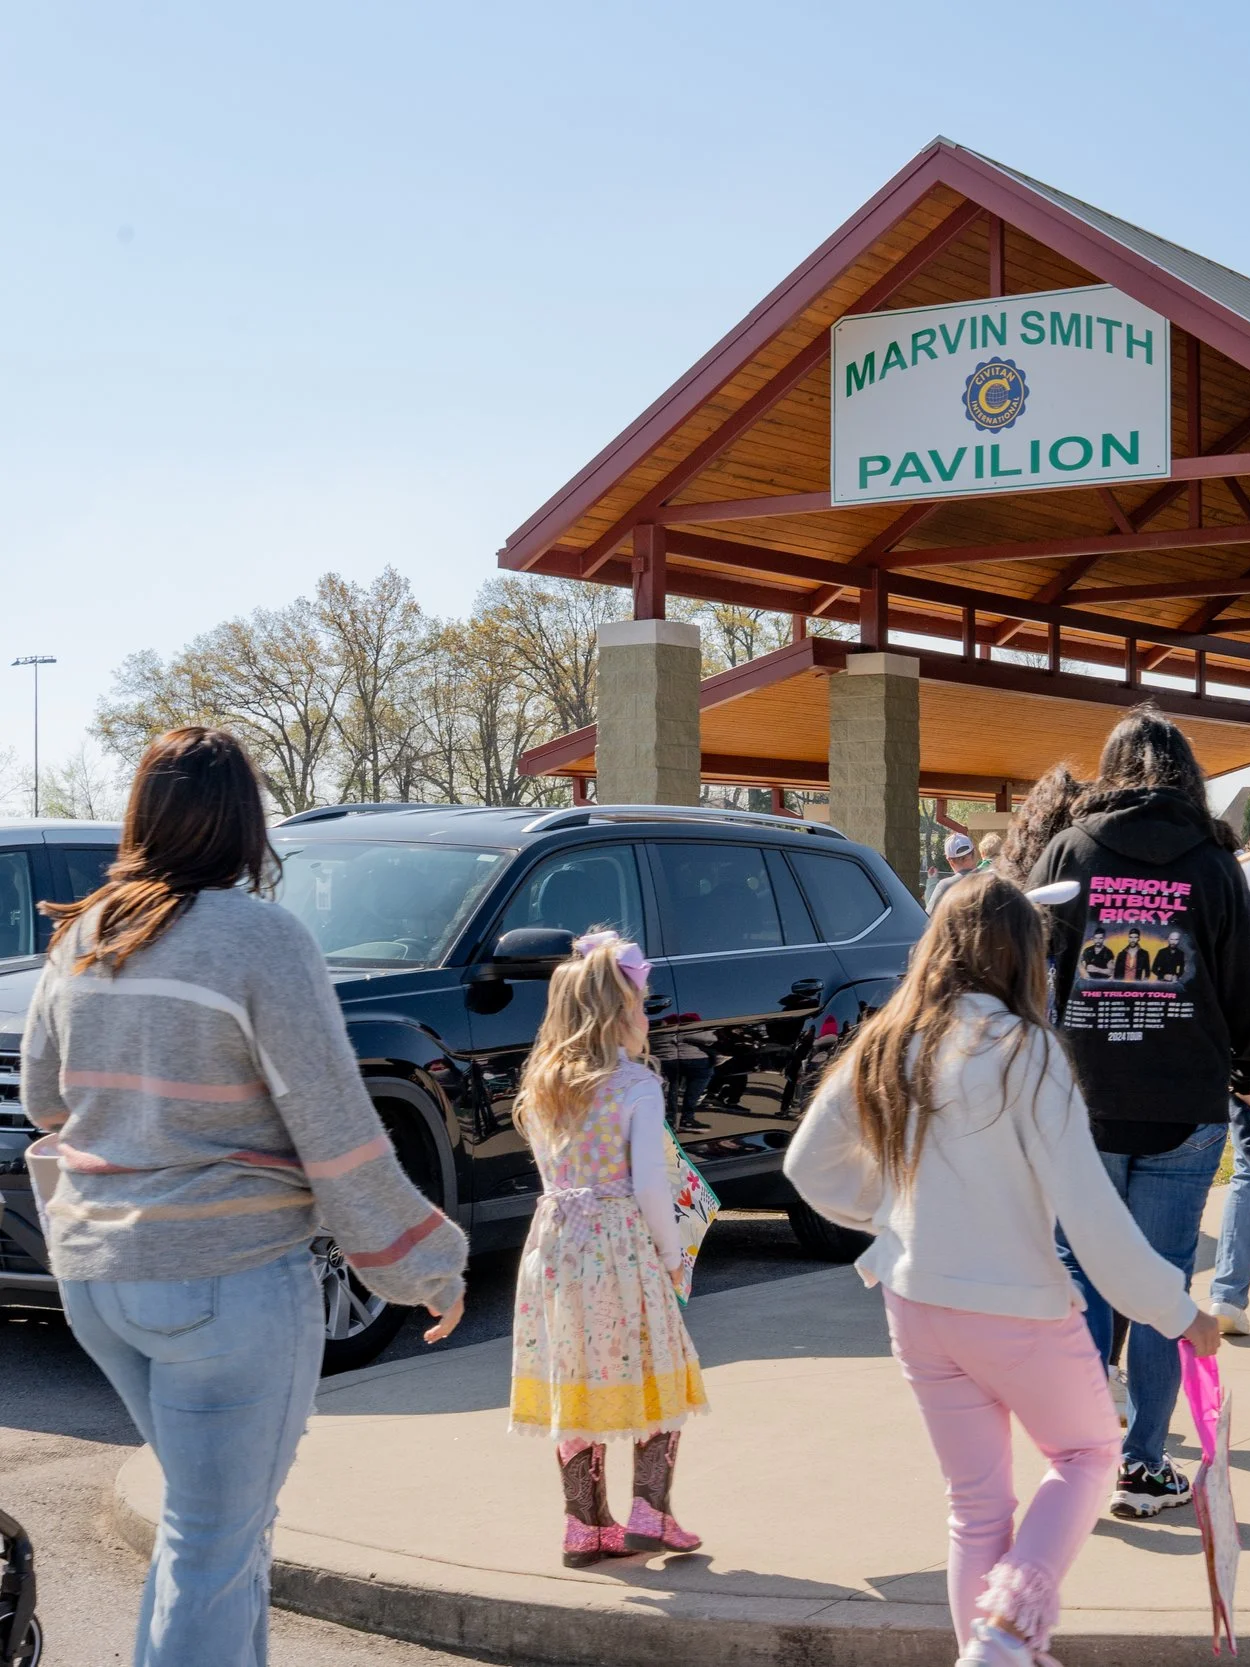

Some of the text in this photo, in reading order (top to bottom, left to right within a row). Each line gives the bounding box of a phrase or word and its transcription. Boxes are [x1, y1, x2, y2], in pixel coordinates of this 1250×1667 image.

[846, 310, 1153, 398] MARVIN SMITH
[975, 367, 1016, 385] CIVITAN
[978, 378, 1011, 414] C
[972, 396, 1020, 424] INTERNATIONAL
[858, 430, 1139, 490] PAVILION
[1090, 876, 1191, 895] ENRIQUE
[1089, 893, 1187, 911] PITBULL
[1099, 908, 1174, 922] RICKY
[1108, 1031, 1143, 1041] 2024 TOUR
